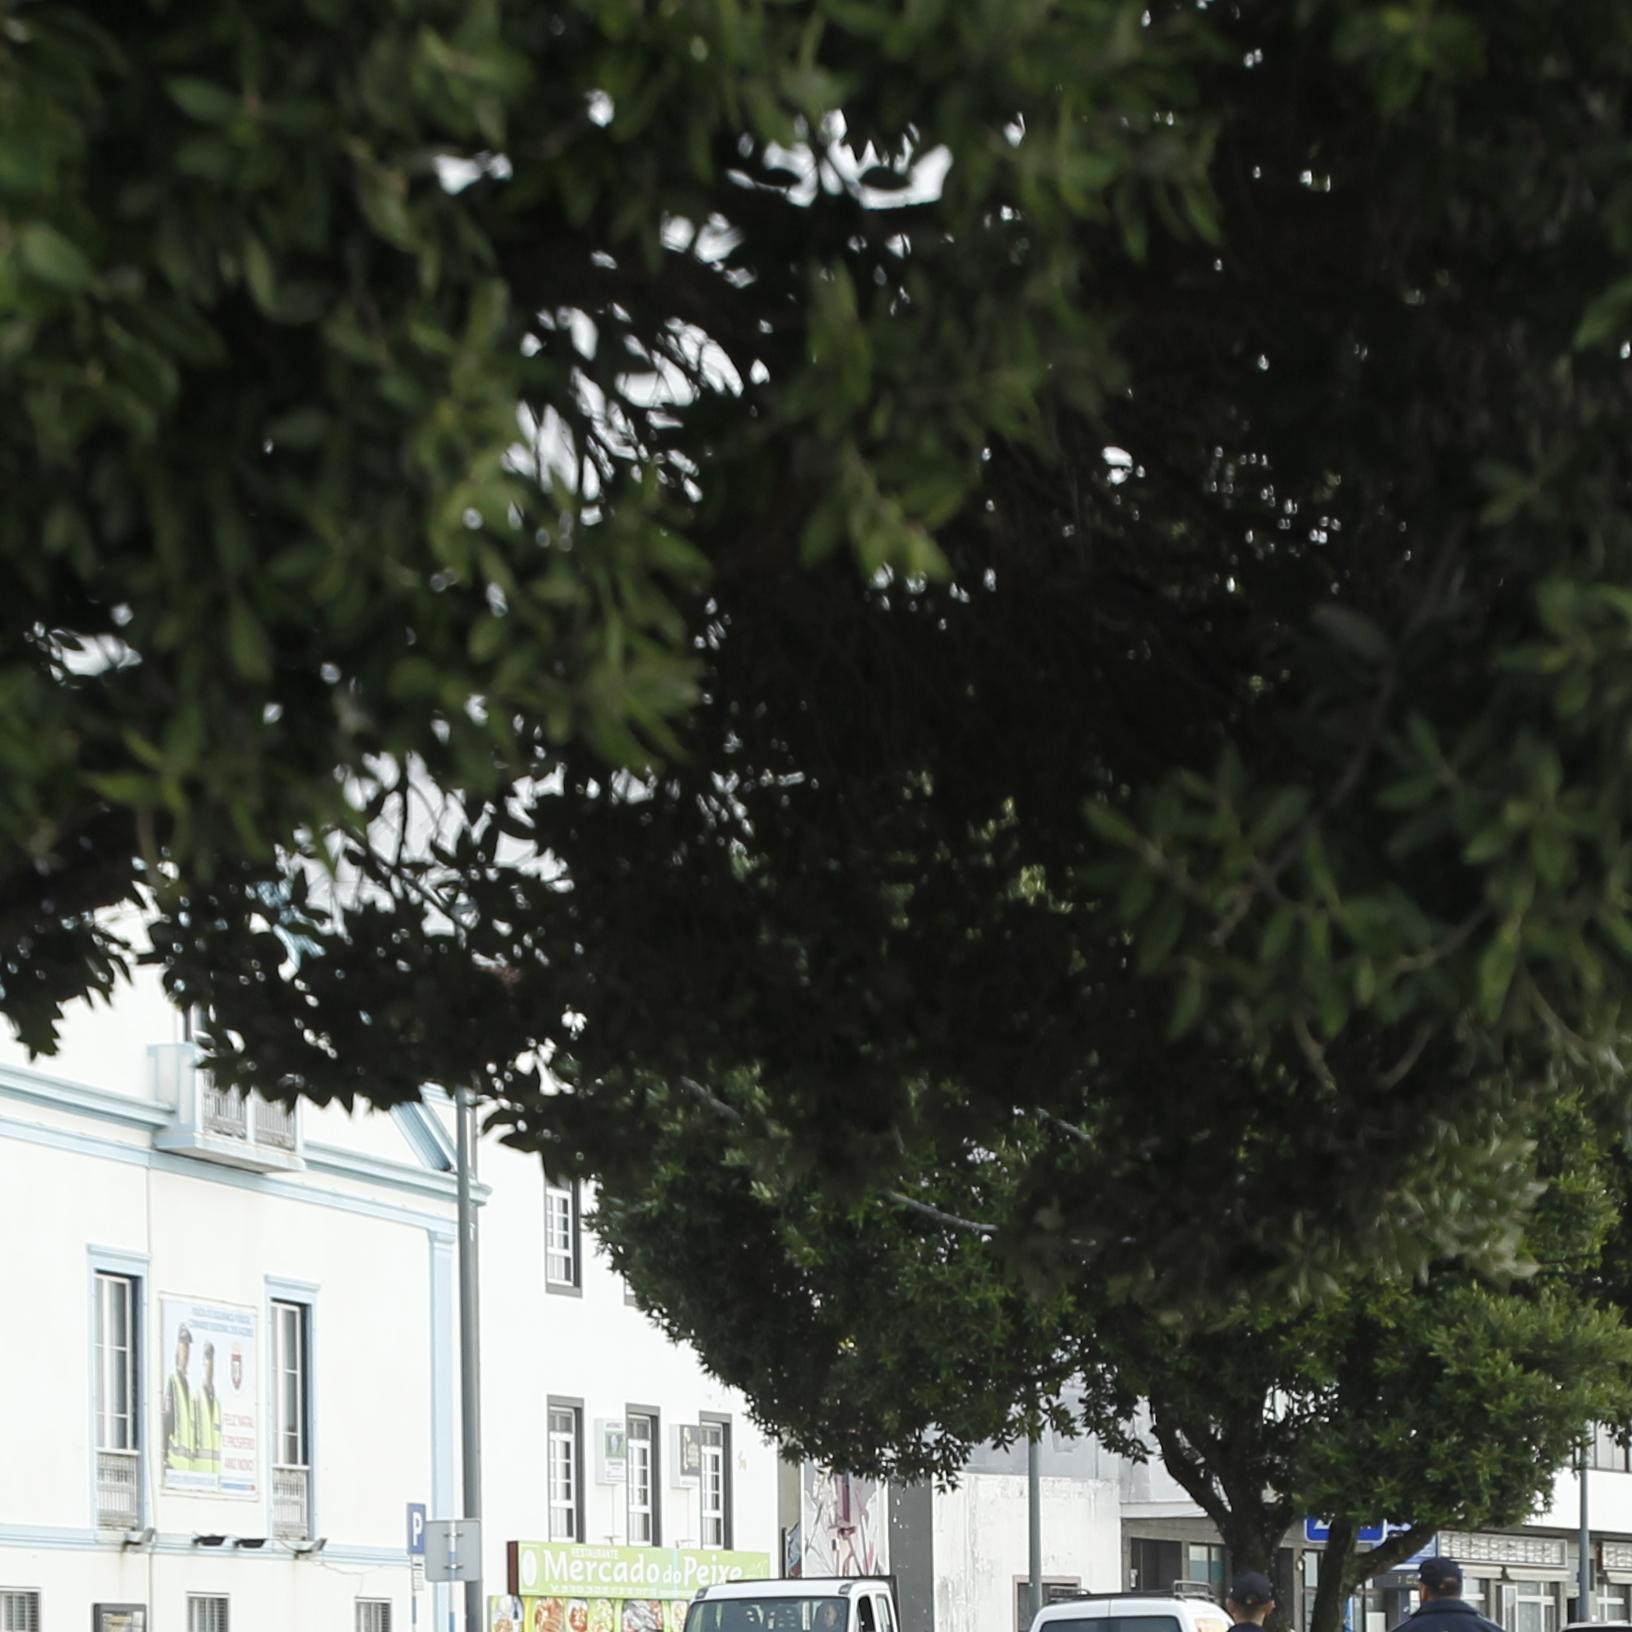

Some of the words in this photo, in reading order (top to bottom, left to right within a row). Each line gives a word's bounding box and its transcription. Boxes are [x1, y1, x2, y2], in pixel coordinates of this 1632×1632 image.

[413, 1512, 423, 1547] P
[543, 1549, 659, 1588] Mercado
[662, 1564, 681, 1585] do
[683, 1554, 743, 1586] Peixe
